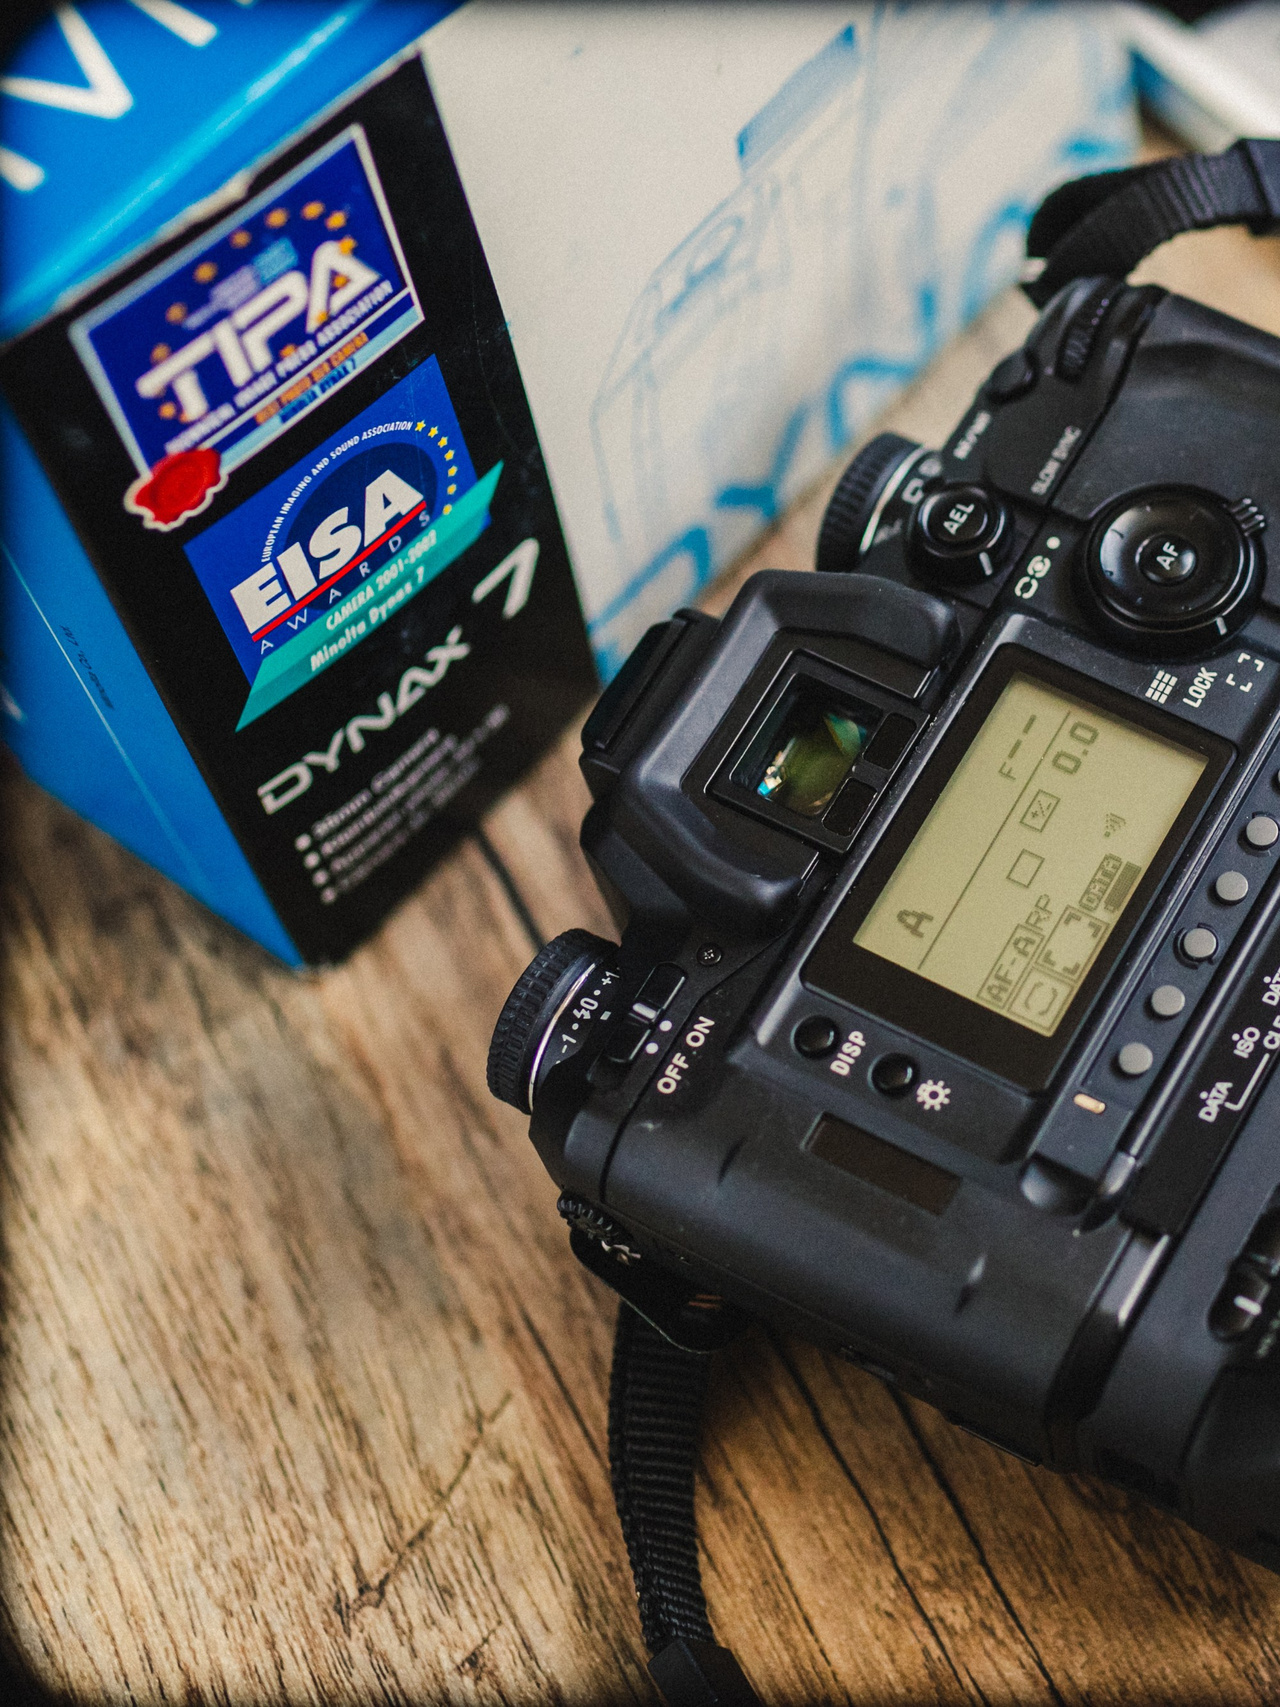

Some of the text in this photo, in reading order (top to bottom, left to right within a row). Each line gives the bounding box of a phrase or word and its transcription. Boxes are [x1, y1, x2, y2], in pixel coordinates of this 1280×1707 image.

[261, 420, 413, 562] EUROPEAN IMAGING AND SOUND ASSOCIATION
[943, 502, 974, 536] AEL
[229, 469, 425, 634] EISA
[472, 538, 539, 619] 7
[1157, 541, 1179, 571] AF
[326, 530, 438, 631] CAMERA 2001-2002
[310, 619, 369, 673] Minolta
[415, 566, 426, 584] 7
[1182, 666, 1218, 708] LOCK
[257, 625, 471, 814] DYNAX
[1052, 720, 1099, 776] 0.0
[1083, 855, 1121, 910] DATA
[897, 909, 934, 939] A
[1025, 893, 1053, 932] RP
[986, 933, 1036, 1002] AF-A
[657, 1016, 716, 1095] OFF ON
[830, 1031, 866, 1076] DISP
[1234, 1026, 1260, 1058] ISO
[1199, 1081, 1233, 1123] DATA
